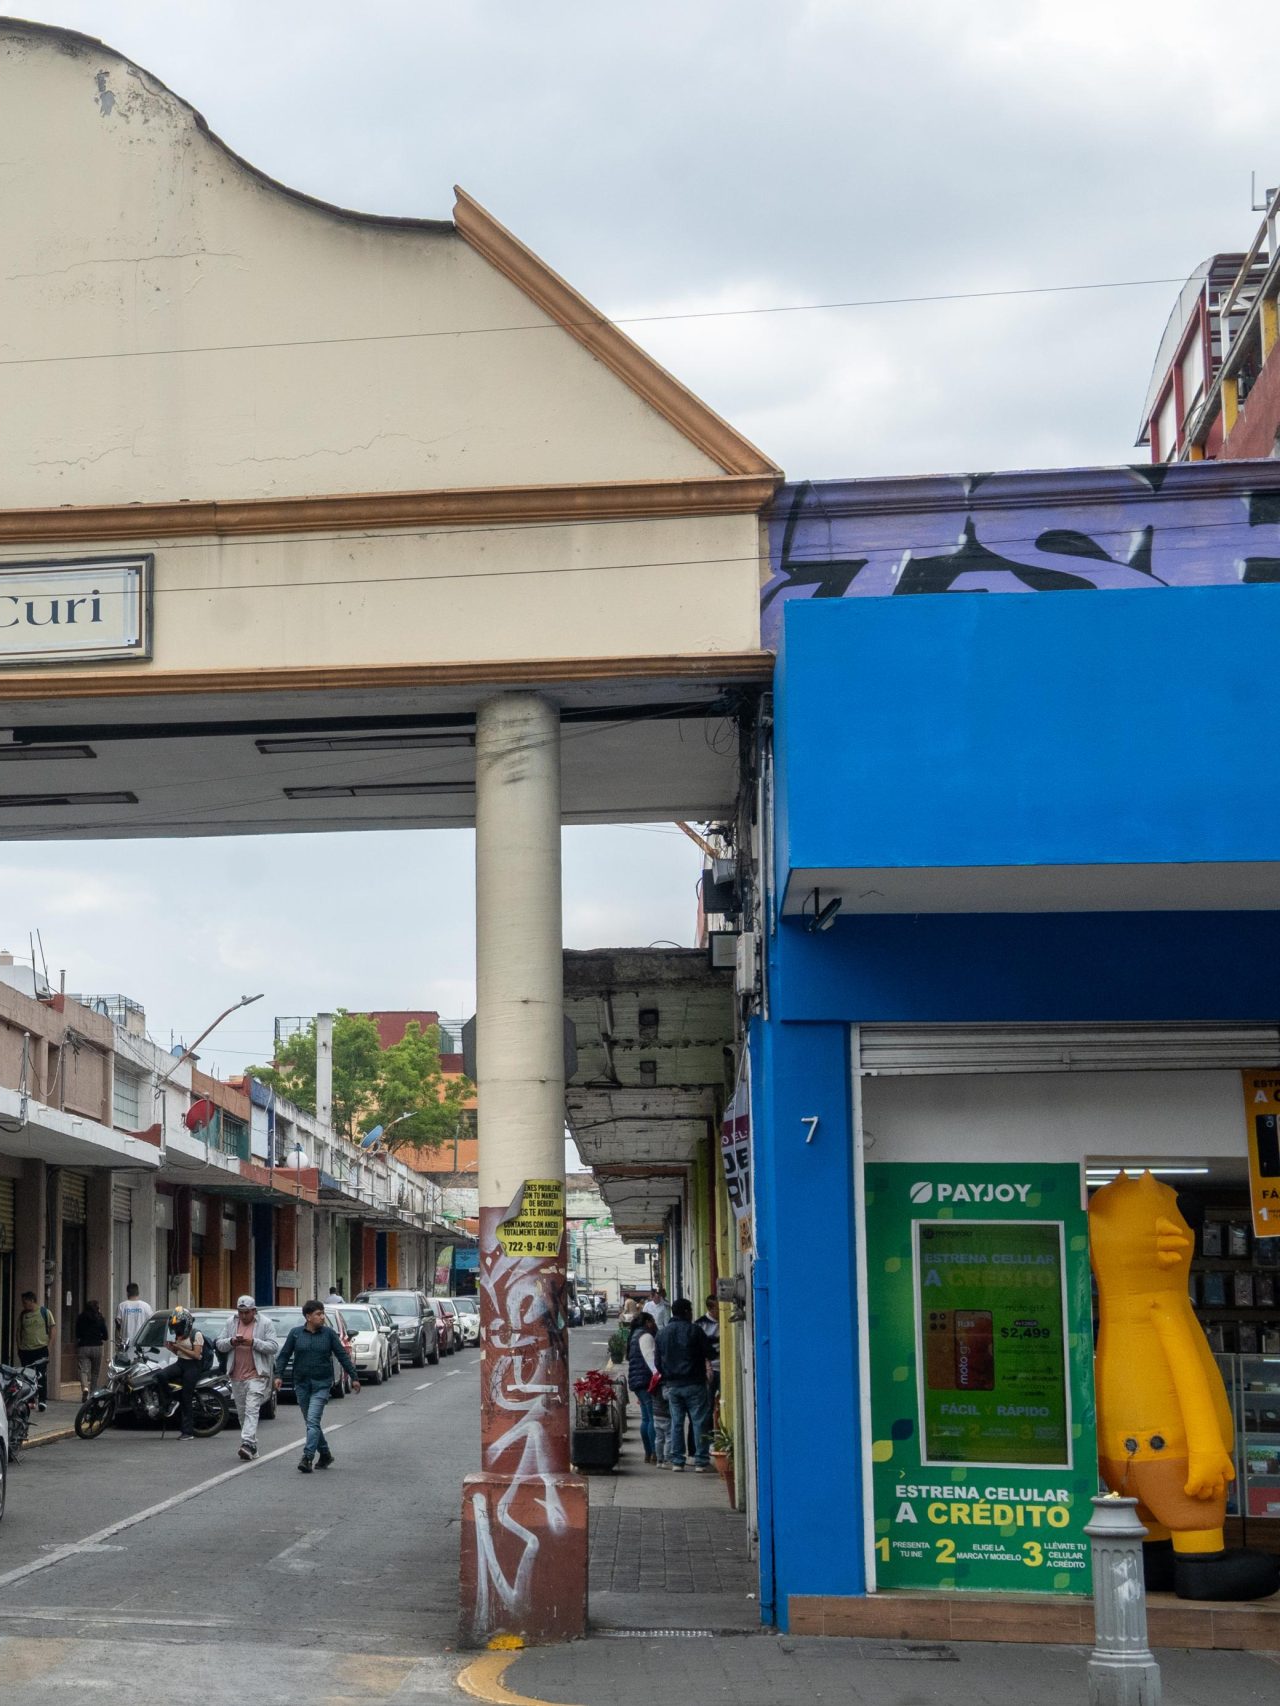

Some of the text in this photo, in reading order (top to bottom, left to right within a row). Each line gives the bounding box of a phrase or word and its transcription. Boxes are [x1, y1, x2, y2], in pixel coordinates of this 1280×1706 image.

[800, 1115, 818, 1143] 7
[937, 1183, 1032, 1202] PAYJOY
[533, 1221, 544, 1229] CON
[503, 1228, 537, 1236] TOTALMENTE
[924, 1253, 1055, 1265] ESTRENA CELULAR
[924, 1269, 942, 1287] A
[1000, 1327, 1050, 1340] $2,499
[940, 1402, 981, 1416] FÁCIL
[996, 1403, 1050, 1417] RÁPIDO
[895, 1484, 1070, 1503] ESTRENA CELULAR
[895, 1499, 1070, 1528] A CRÉDITO
[874, 1537, 890, 1562] 1
[892, 1541, 931, 1549] PRESENTA
[935, 1538, 956, 1564] 2
[972, 1543, 1005, 1552] ELIGE LA
[1043, 1541, 1087, 1551] LLÉVATE TU
[900, 1550, 923, 1558] TU INE
[956, 1552, 984, 1560] MARCA
[990, 1553, 1022, 1561] MODELO
[1022, 1541, 1044, 1567] 3
[1048, 1551, 1083, 1560] CELULAR
[1053, 1560, 1086, 1569] CRÉDITO
